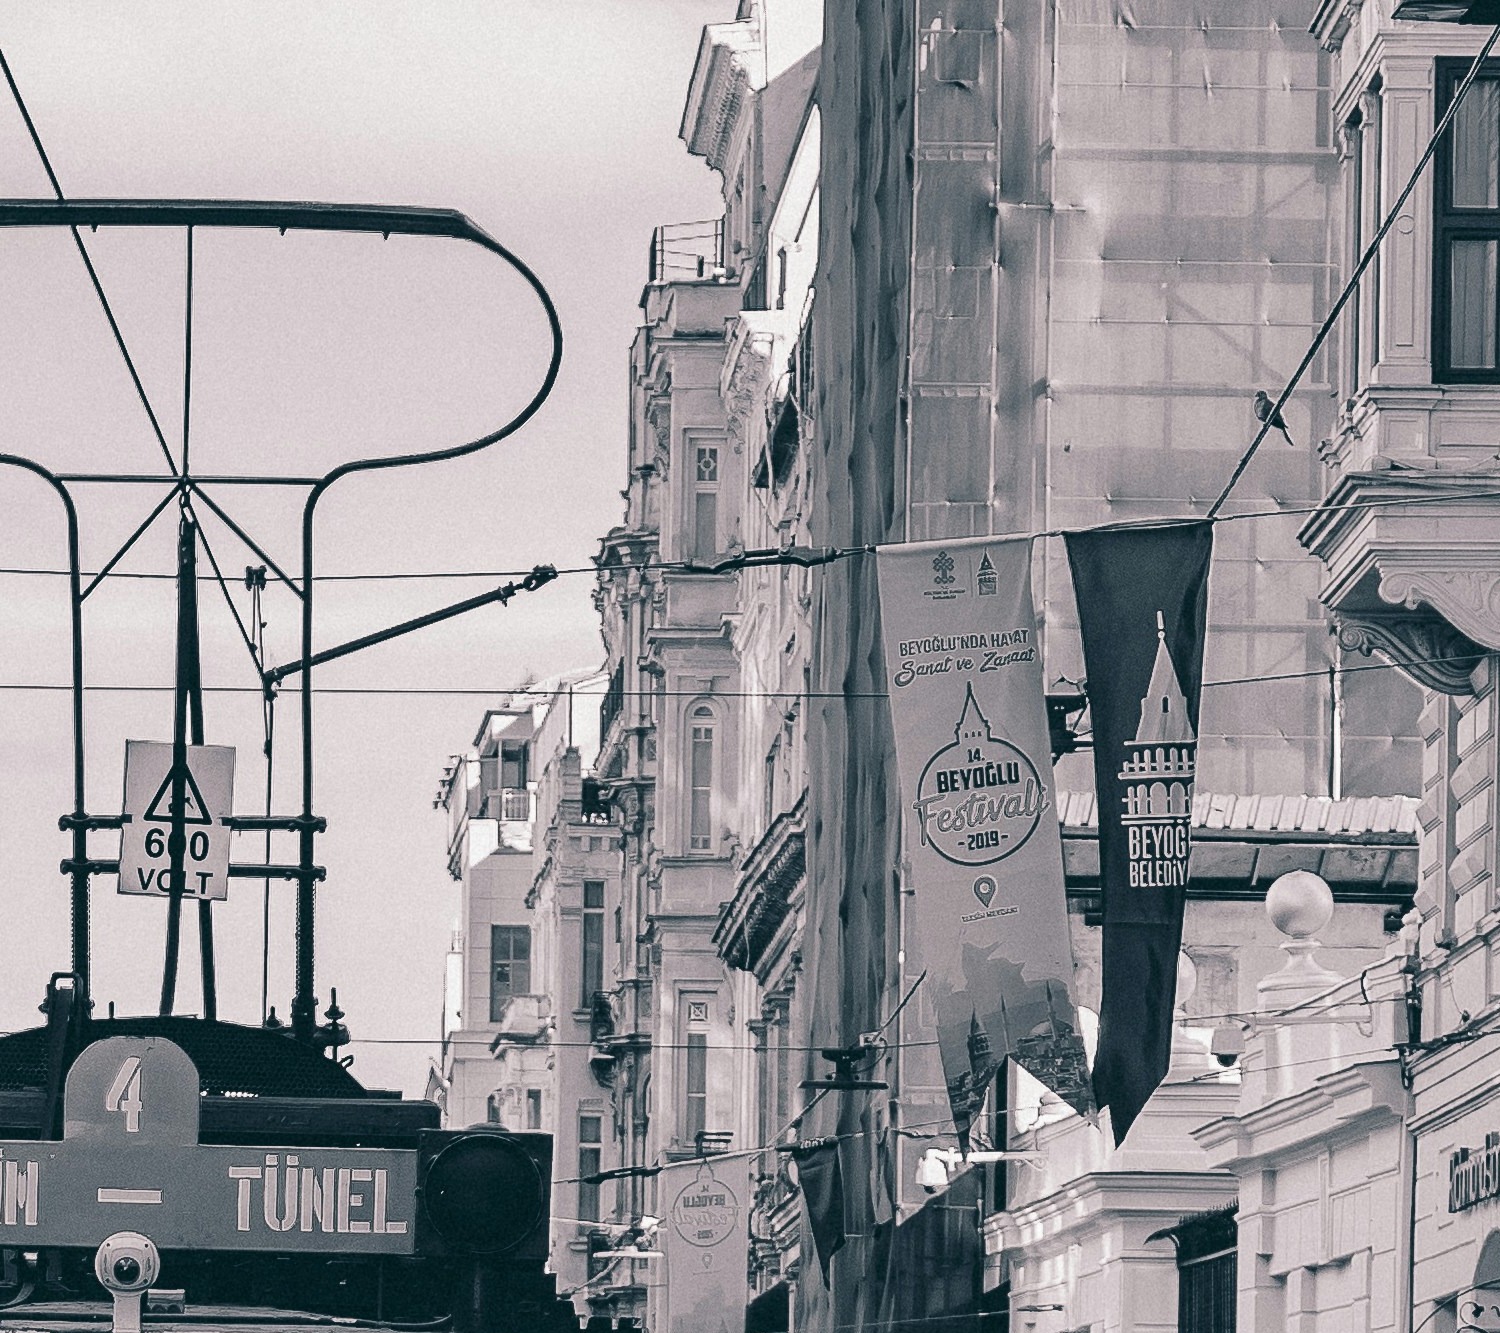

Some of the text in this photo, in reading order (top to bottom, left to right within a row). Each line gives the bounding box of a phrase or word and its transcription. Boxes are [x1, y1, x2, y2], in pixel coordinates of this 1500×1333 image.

[899, 629, 1029, 657] BEYOĞLU'NDA HAYAT
[956, 657, 974, 671] ve
[966, 749, 985, 763] 14.
[936, 762, 1020, 793] BEYOĞLU
[913, 777, 1050, 847] Festivali
[144, 827, 210, 862] 60
[105, 1056, 142, 1132] 4
[228, 1152, 408, 1234] TÜNEL
